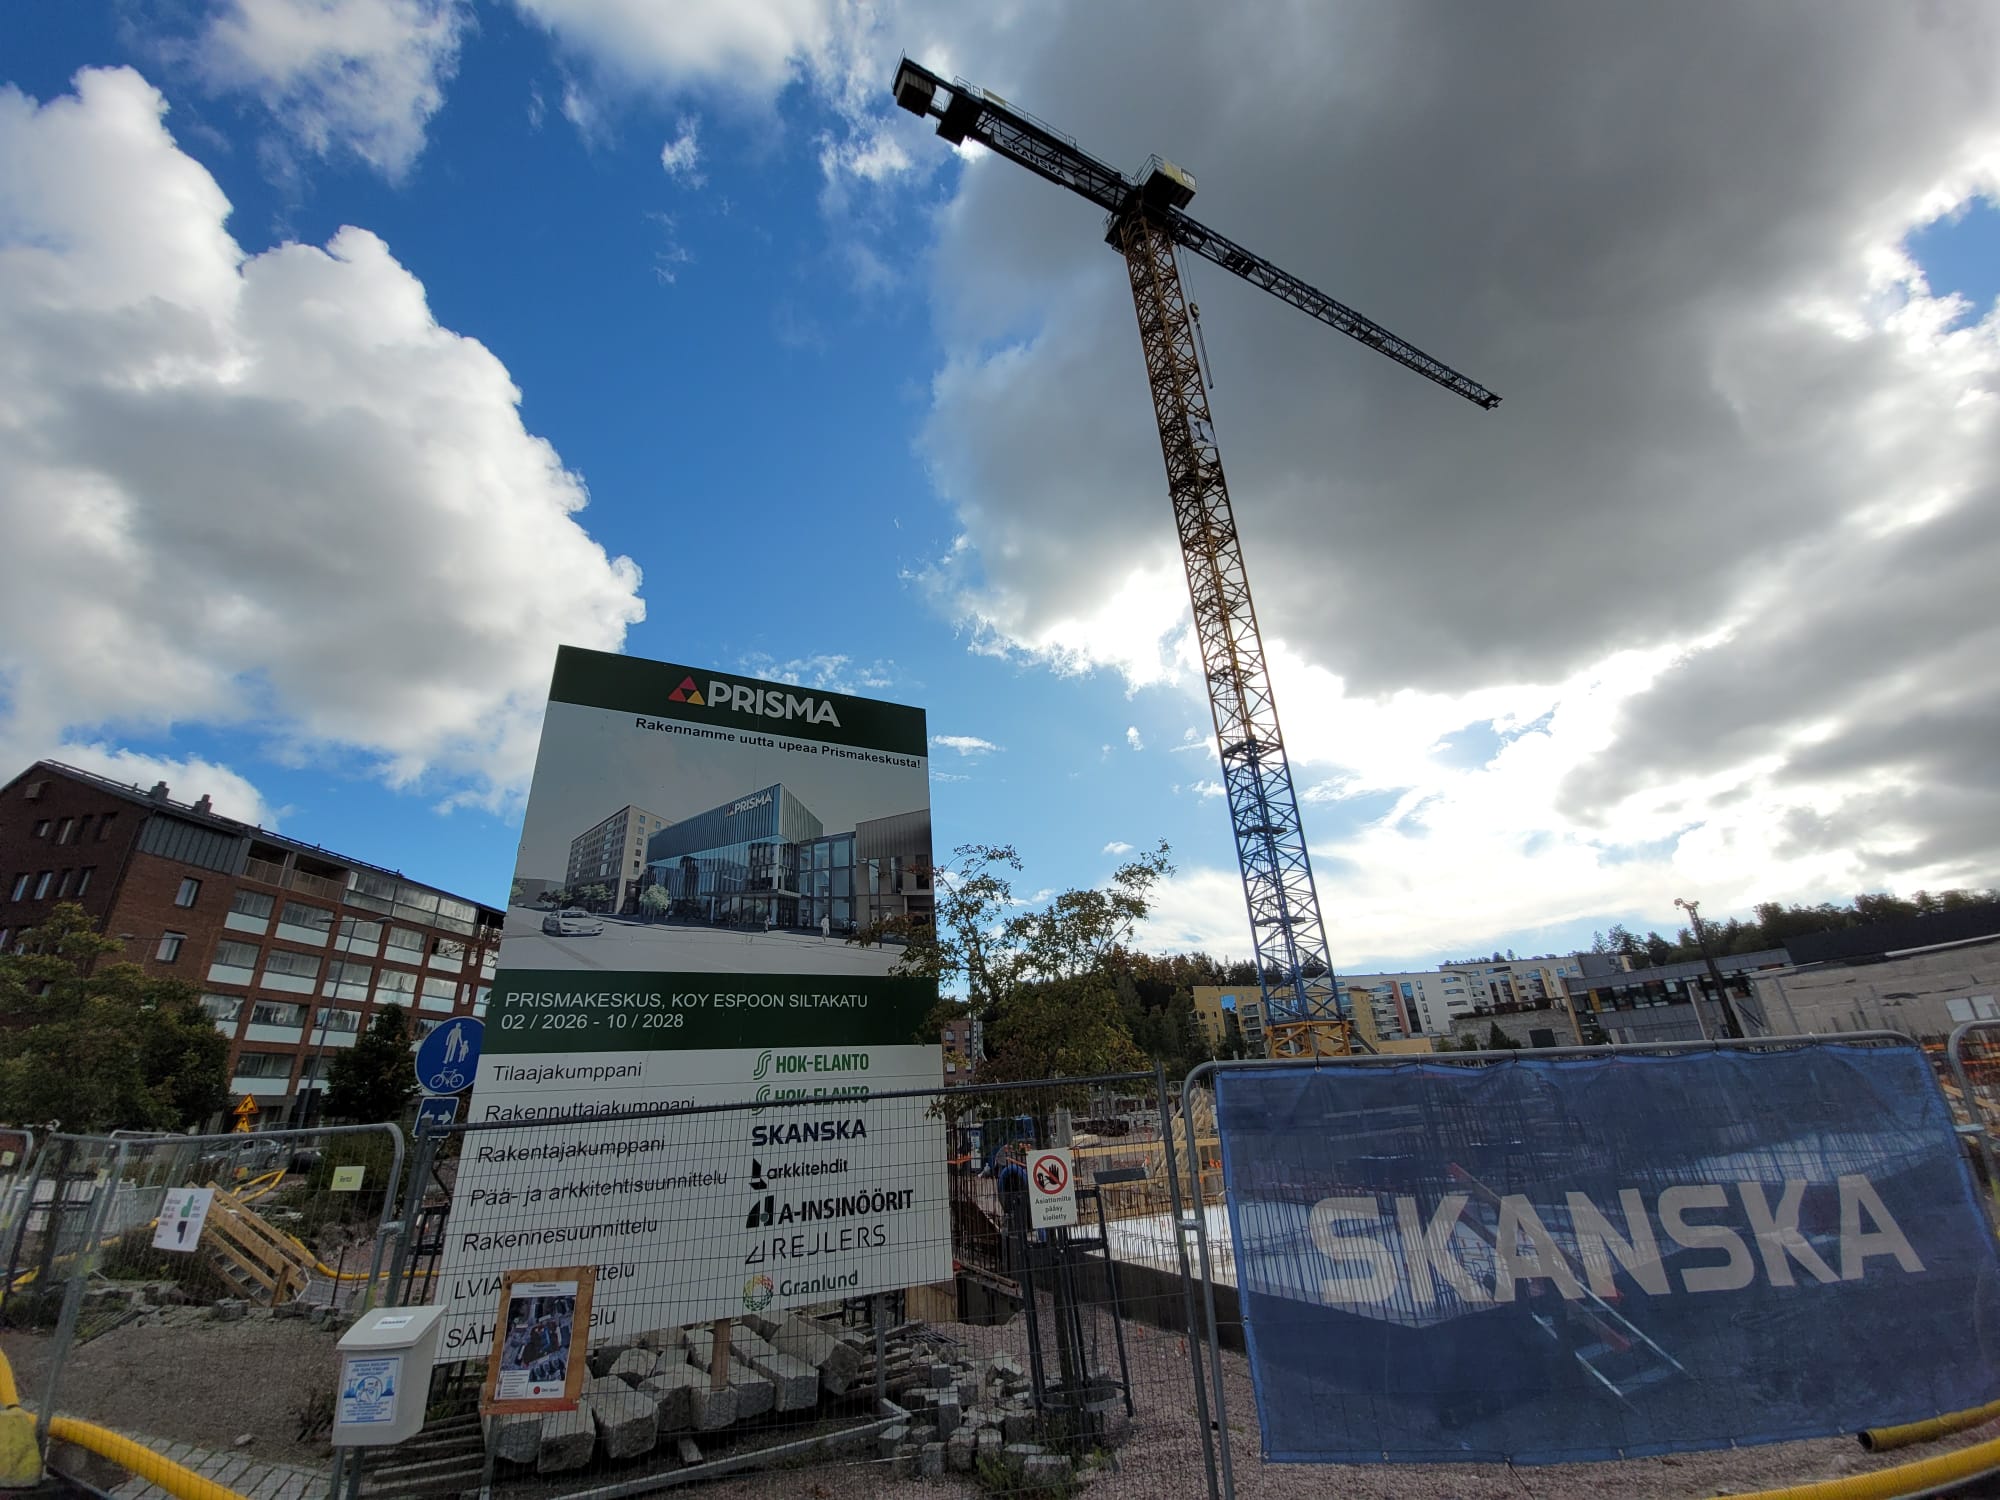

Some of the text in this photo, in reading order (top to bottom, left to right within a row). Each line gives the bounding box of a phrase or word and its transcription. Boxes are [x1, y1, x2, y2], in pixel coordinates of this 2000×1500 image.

[1002, 139, 1066, 179] SKANSKA
[707, 680, 842, 728] PRISMA
[635, 717, 921, 769] Rakennamme uutta upeaa Prismakeskusta!
[734, 792, 773, 813] PRISMA
[505, 992, 868, 1010] PRISMAKESKUS, KOY ESPOON SILTAKATU
[501, 1014, 524, 1030] 02
[542, 1013, 587, 1030] 2026
[607, 1014, 627, 1029] 10
[642, 1013, 684, 1029] 2028
[492, 1062, 643, 1083] Tilaajakumppani
[775, 1053, 869, 1074] HOK-ELANTO
[752, 1119, 867, 1147] SKANSKA
[477, 1136, 665, 1163] Rakentajakumppani
[470, 1170, 728, 1207] Pää- ja arkkitehtisuunnittelu
[778, 1188, 914, 1225] A-INSINÖÖRIT
[462, 1217, 658, 1252] Rakennesuunnittelu
[773, 1224, 886, 1261] REJLERS
[1308, 1174, 1927, 1304] SKANSKA
[780, 1269, 858, 1297] Granlund
